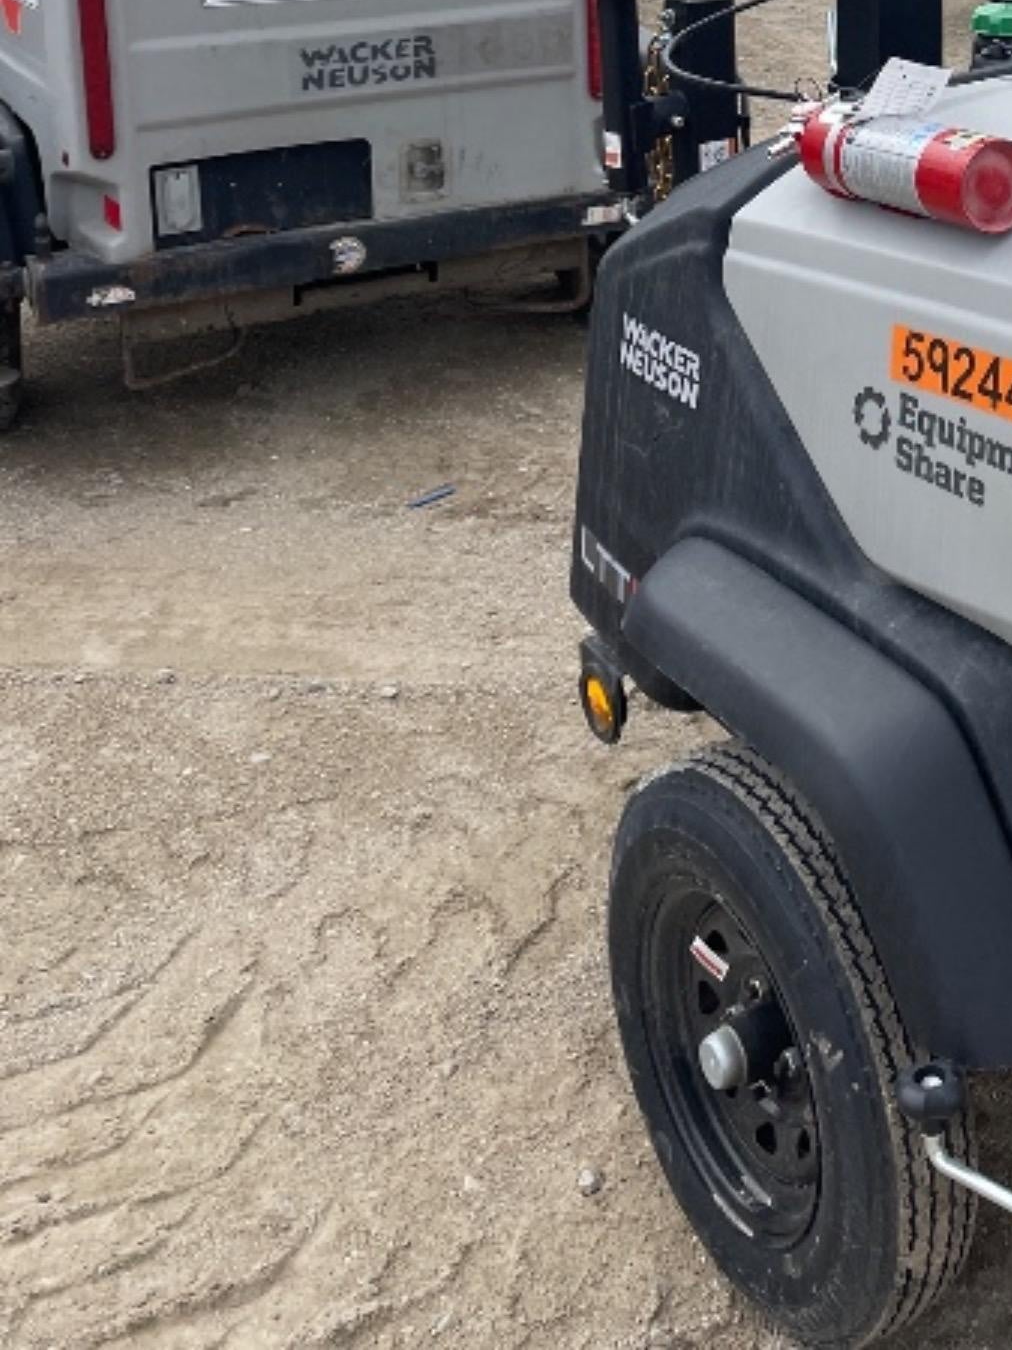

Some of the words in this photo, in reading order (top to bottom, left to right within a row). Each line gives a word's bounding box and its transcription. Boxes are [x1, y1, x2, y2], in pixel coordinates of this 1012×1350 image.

[301, 35, 436, 69] WACKER
[301, 56, 437, 92] NEUSON
[619, 341, 700, 409] NEUSON
[623, 312, 700, 382] WACKER
[895, 434, 985, 507] Share
